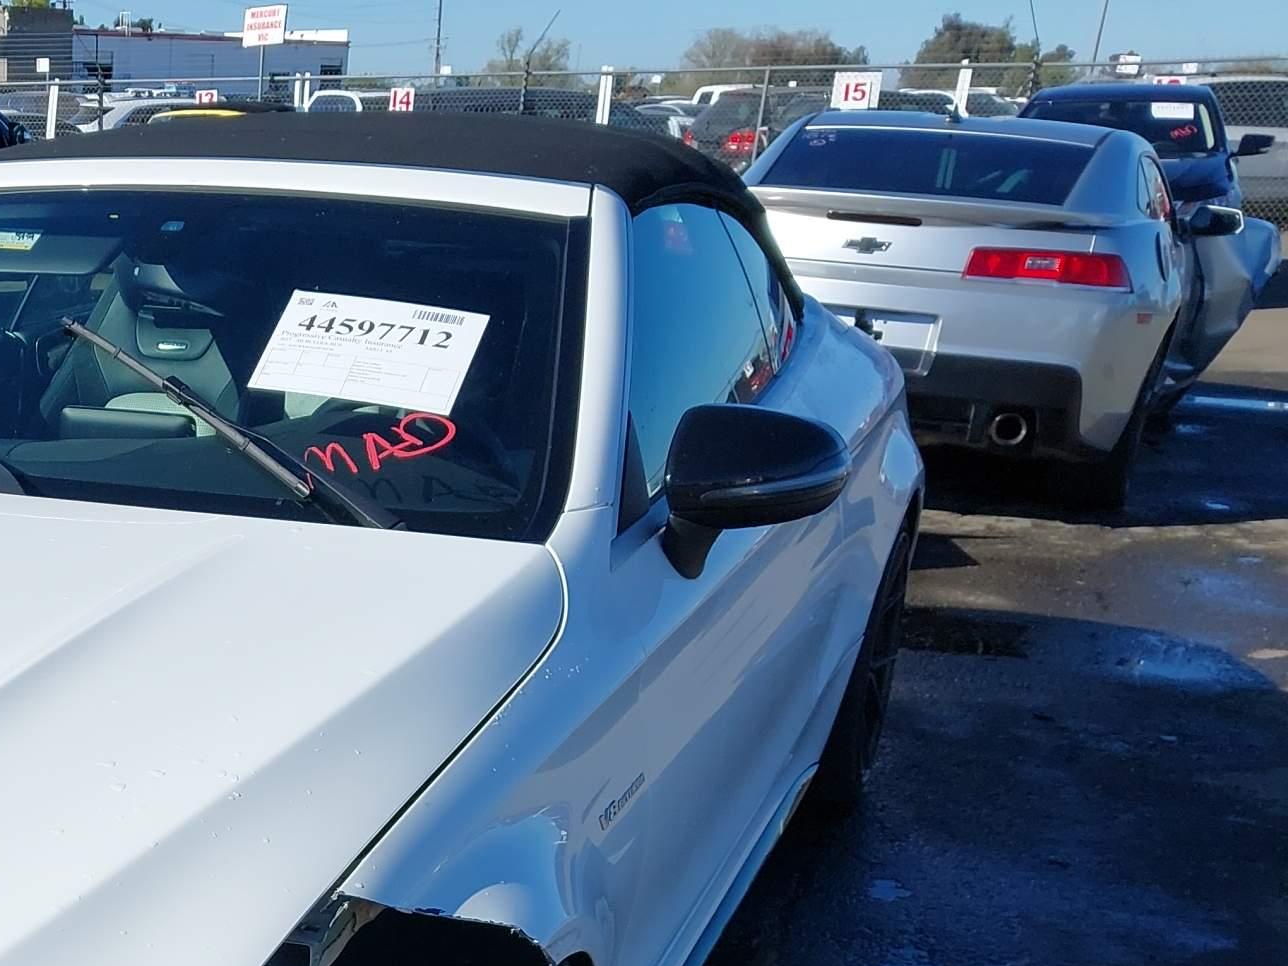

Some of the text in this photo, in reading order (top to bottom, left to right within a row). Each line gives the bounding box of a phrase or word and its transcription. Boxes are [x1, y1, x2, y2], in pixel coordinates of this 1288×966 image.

[246, 20, 282, 31] INSURANCE
[392, 90, 411, 111] 14
[842, 82, 867, 102] 15
[298, 314, 453, 349] 44597712
[364, 338, 404, 350] Insurance
[304, 412, 456, 490] MAD
